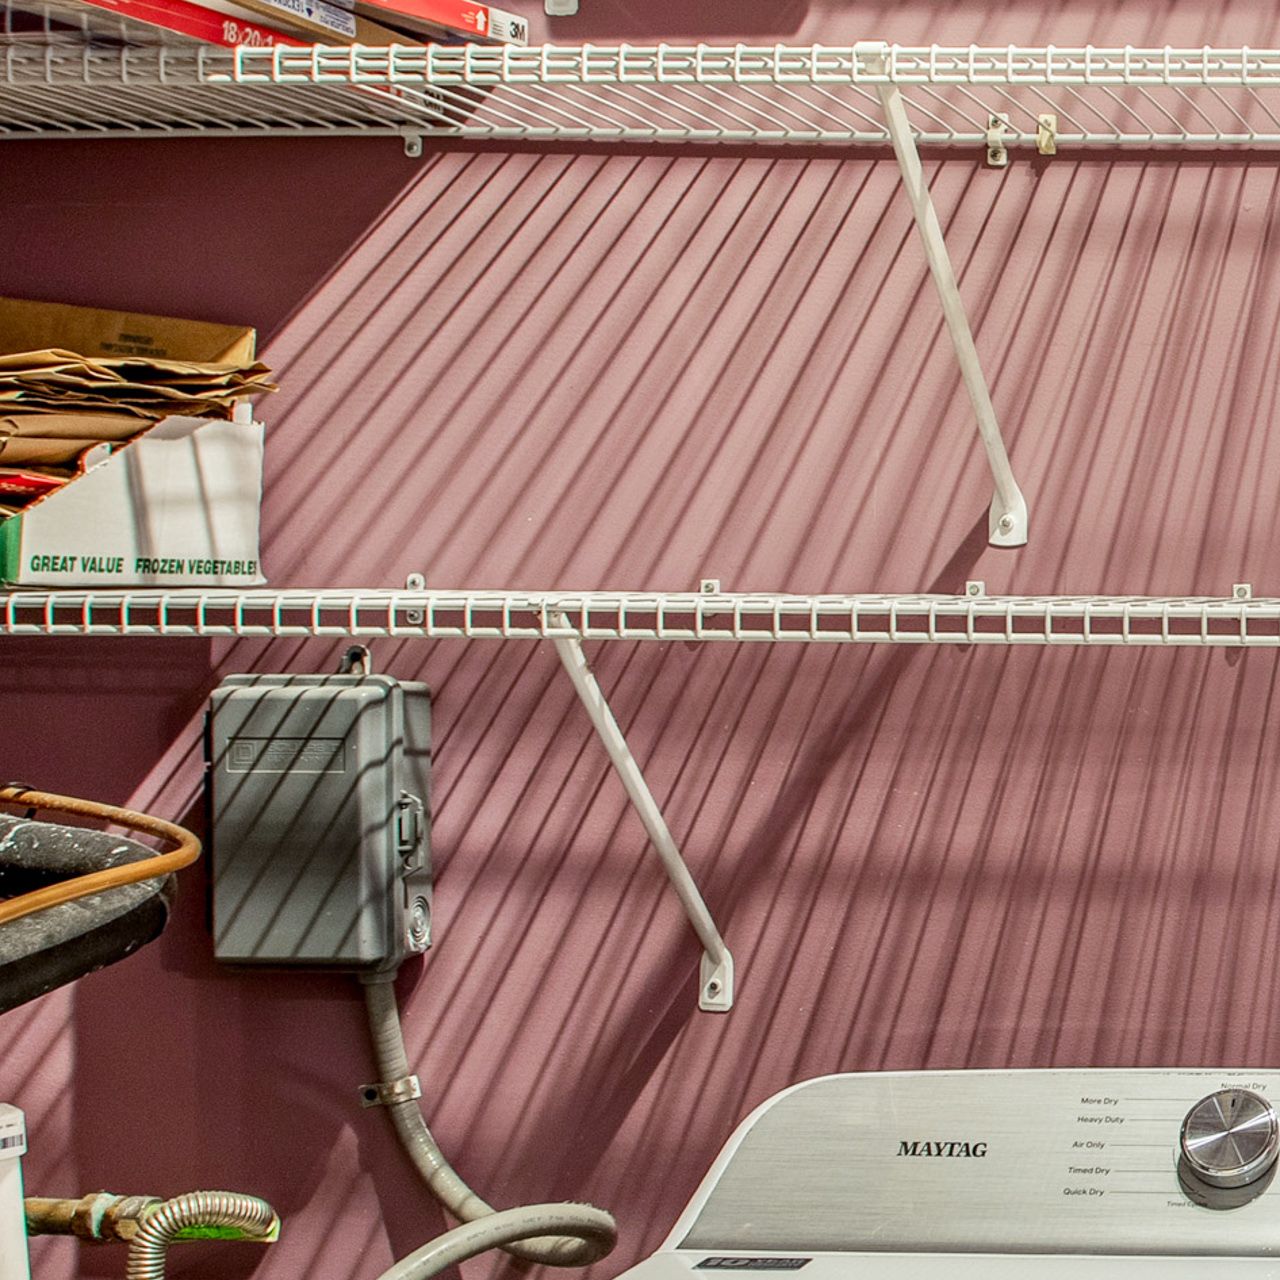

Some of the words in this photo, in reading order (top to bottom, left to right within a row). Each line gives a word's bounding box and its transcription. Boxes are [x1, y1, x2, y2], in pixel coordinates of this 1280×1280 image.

[509, 22, 526, 39] 3M
[30, 555, 77, 573] GREAT
[81, 556, 124, 574] VALUE
[134, 557, 184, 575] FROZEN
[1080, 1097, 1101, 1105] More
[1103, 1097, 1119, 1106] Dry
[1077, 1116, 1104, 1124] Heavy
[1106, 1116, 1125, 1124] Duty
[896, 1141, 988, 1158] MAYTAG
[1086, 1141, 1105, 1150] Only
[1095, 1167, 1110, 1175] Dry
[1063, 1188, 1087, 1197] Quick
[1089, 1188, 1105, 1197] Dry
